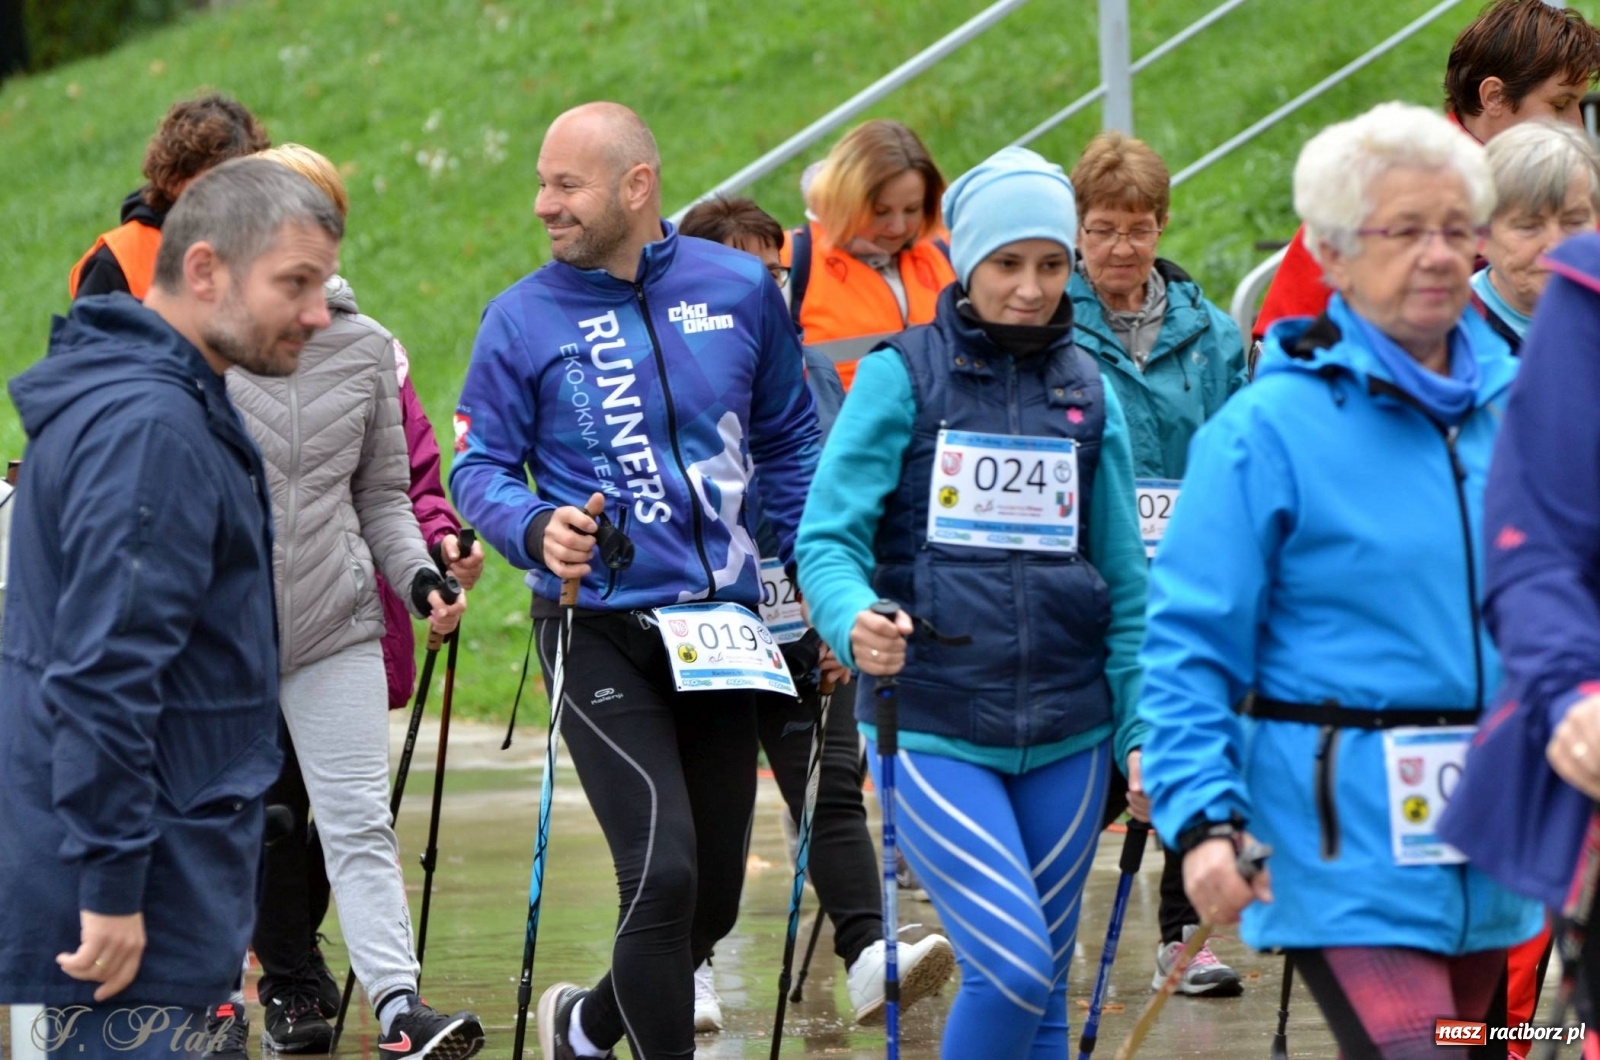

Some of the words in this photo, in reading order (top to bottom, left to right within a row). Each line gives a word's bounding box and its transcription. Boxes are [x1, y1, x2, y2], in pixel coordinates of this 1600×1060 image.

[560, 343, 600, 450] EKO-OKNA
[578, 310, 672, 524] RUNNERS
[974, 456, 1047, 494] 024
[1137, 493, 1179, 519] 02
[698, 622, 758, 652] 019
